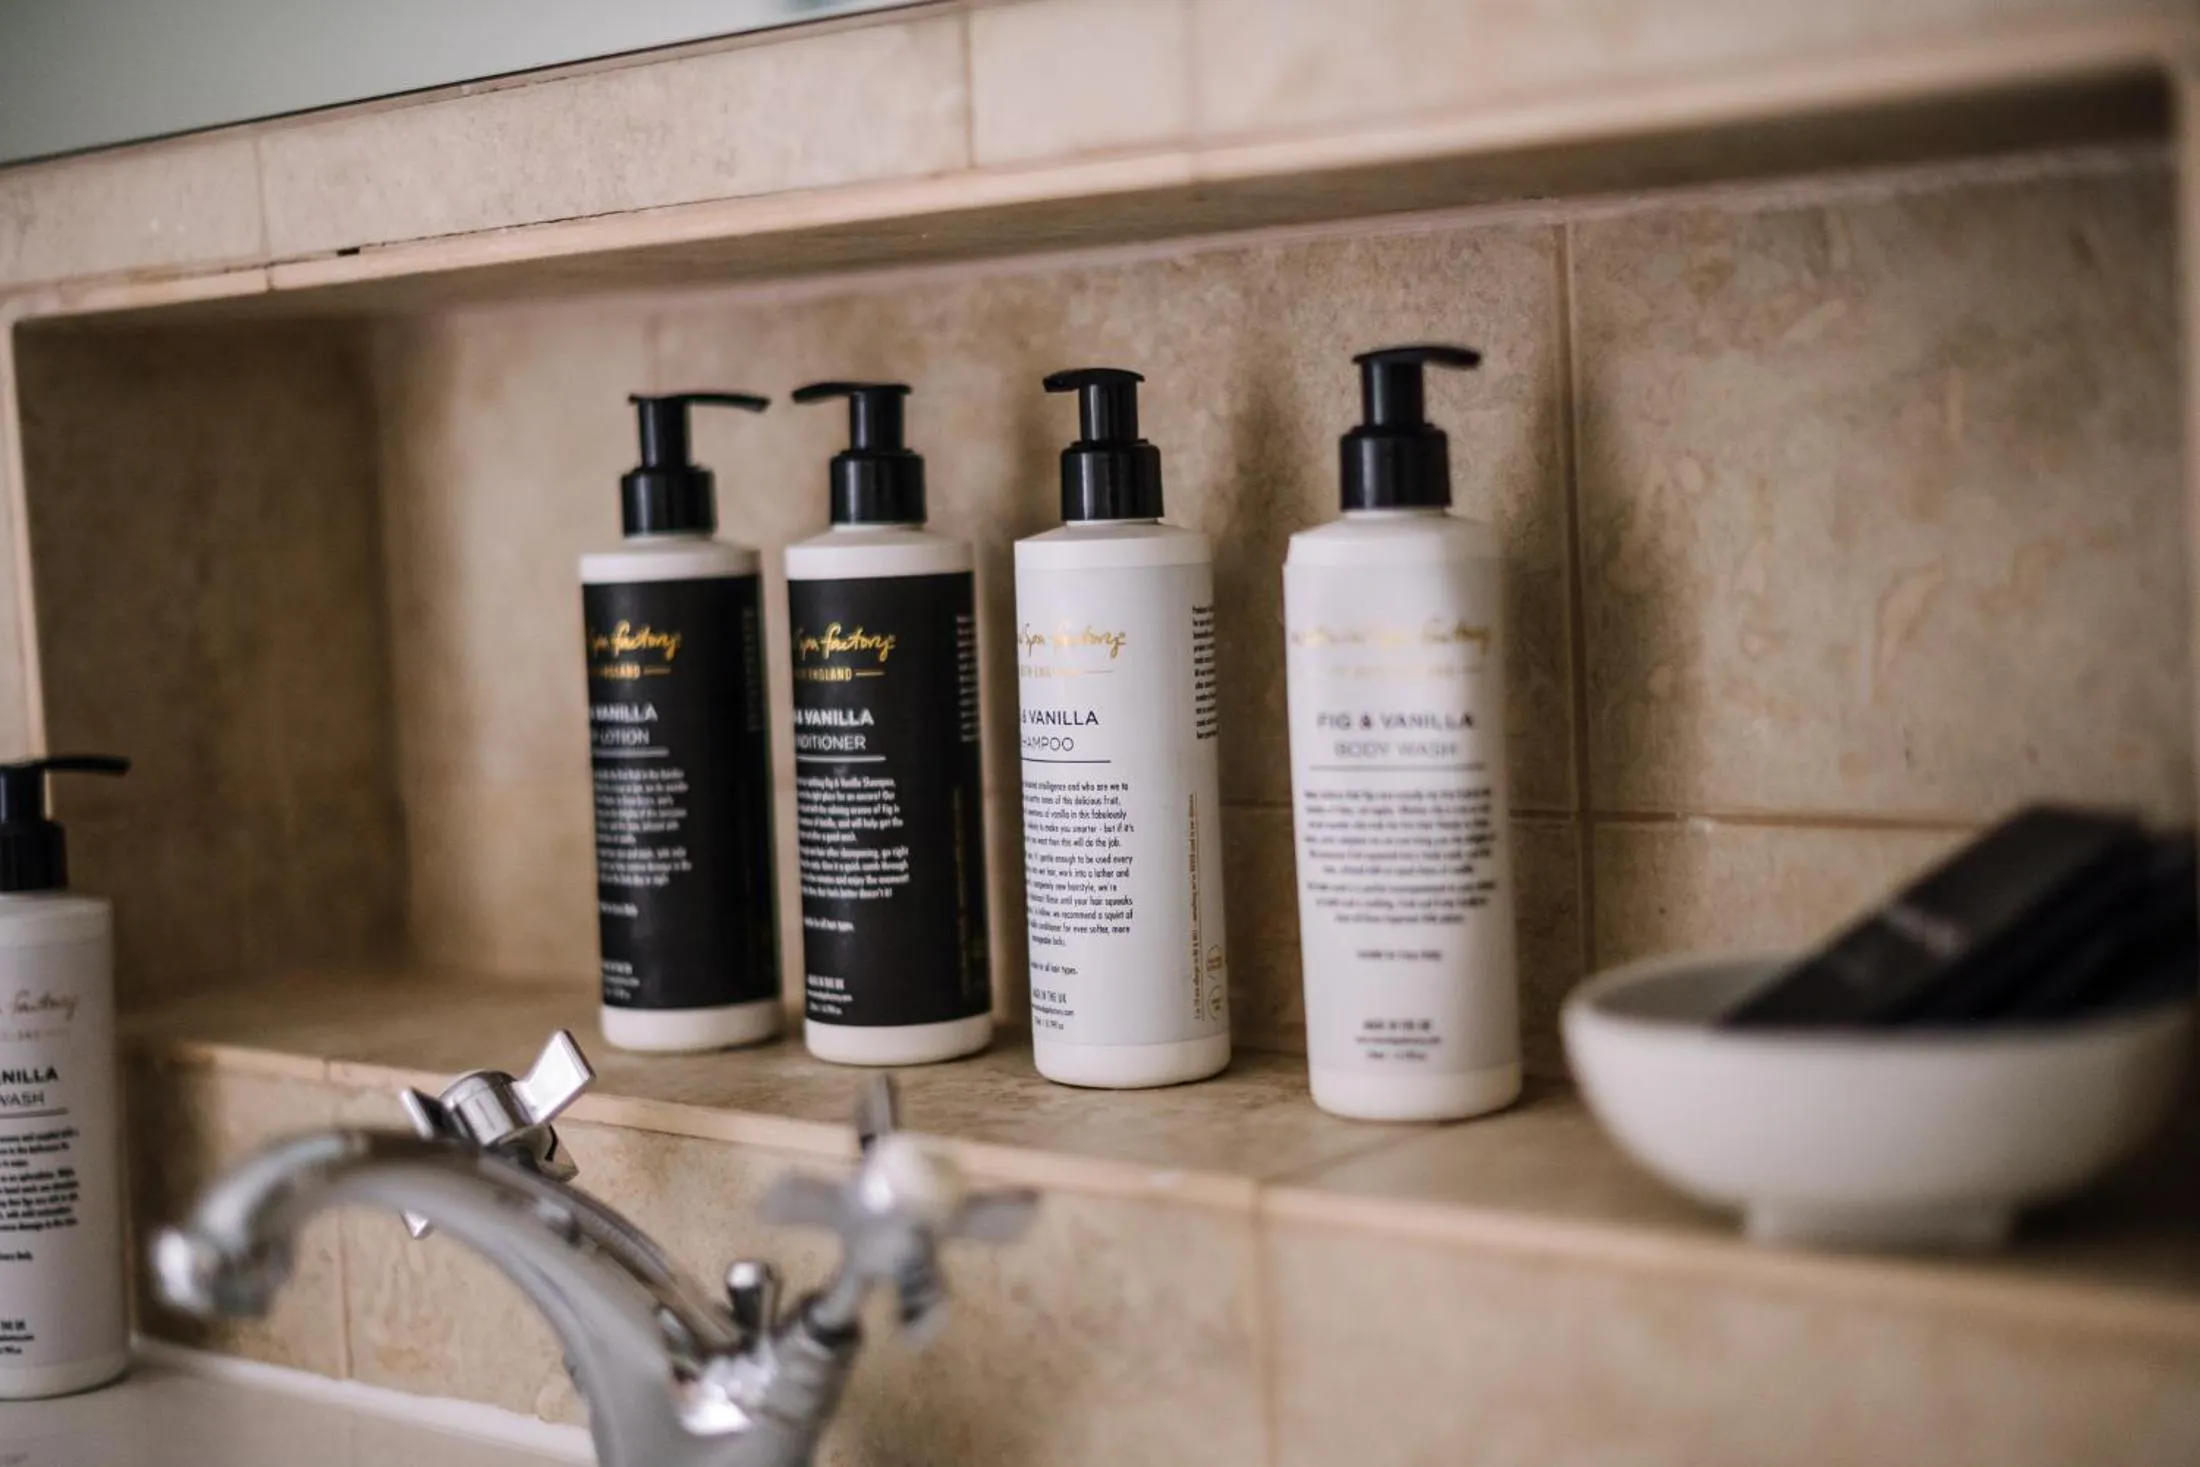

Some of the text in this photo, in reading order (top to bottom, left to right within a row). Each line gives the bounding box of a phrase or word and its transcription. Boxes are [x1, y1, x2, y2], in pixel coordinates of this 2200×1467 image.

[804, 707, 875, 727] VANILLA
[1029, 709, 1100, 726] VANILLA
[1316, 711, 1475, 731] FIG & VANILLA
[1333, 740, 1459, 759] BODY WASH
